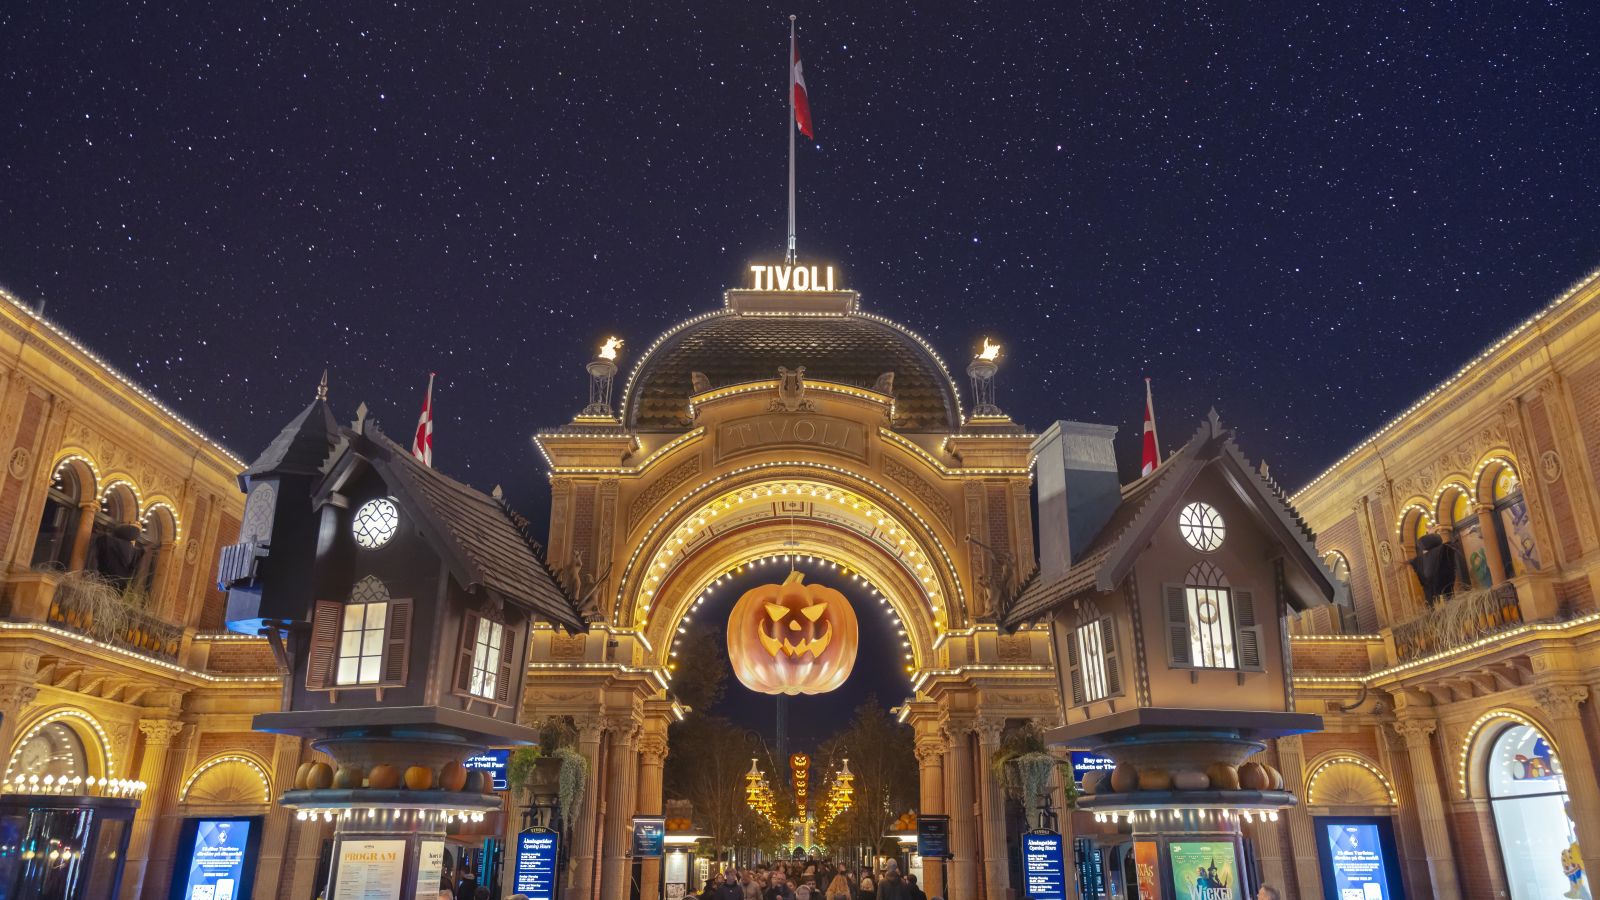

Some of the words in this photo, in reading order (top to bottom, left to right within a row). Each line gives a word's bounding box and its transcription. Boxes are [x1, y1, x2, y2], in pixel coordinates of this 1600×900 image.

[751, 265, 834, 291] TIVOLI
[728, 419, 857, 449] TIVOLI
[345, 852, 397, 861] PROGRAM
